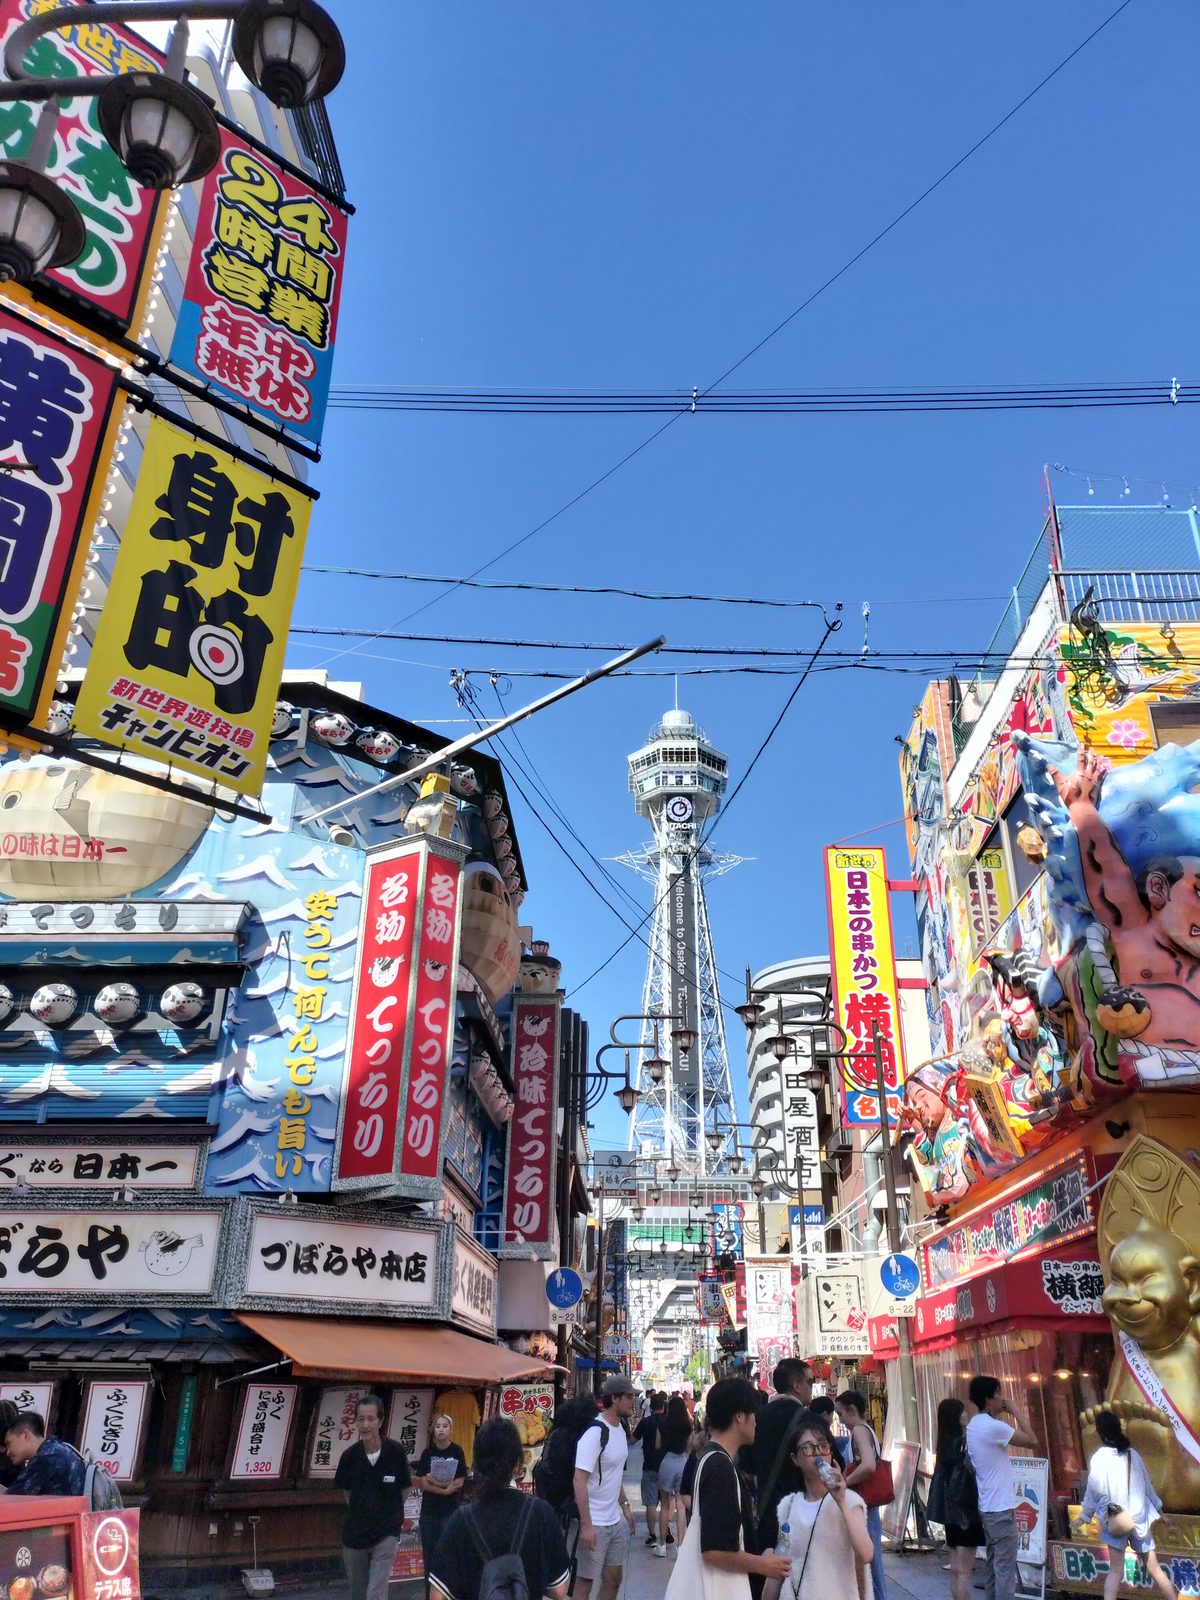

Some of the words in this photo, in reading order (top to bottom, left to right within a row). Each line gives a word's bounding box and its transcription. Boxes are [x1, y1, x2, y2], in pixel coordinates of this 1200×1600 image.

[219, 150, 336, 253] 24
[217, 201, 331, 298] 時間
[207, 248, 323, 345] 営業
[208, 306, 308, 374] 年中
[203, 340, 308, 416] 無休
[122, 451, 294, 714] 射的
[102, 703, 252, 778] チャンピオン
[110, 677, 255, 749] 新世界遊技場
[835, 853, 877, 869] 新世界
[375, 871, 409, 945] 名物
[426, 871, 456, 945] 名物
[675, 876, 686, 924] Welcome
[676, 926, 685, 937] to
[846, 870, 878, 991] 日本一の串かつ
[676, 941, 687, 976] Osaka
[274, 888, 338, 1179] 安うて何んでも旨い
[845, 993, 896, 1090] 横綱
[353, 996, 398, 1159] てっちり
[407, 998, 447, 1158] てっちり
[513, 1043, 548, 1235] 珍味てっちり
[260, 1240, 428, 1284] づぼらや本店
[1045, 1272, 1106, 1301] 横綱
[248, 1390, 272, 1456] にぎり盛合せ
[269, 1389, 285, 1420] ふぐ
[502, 1387, 553, 1416] 串かつ
[314, 1415, 336, 1466] ふぐ料理
[94, 1576, 132, 1600] テラス席
